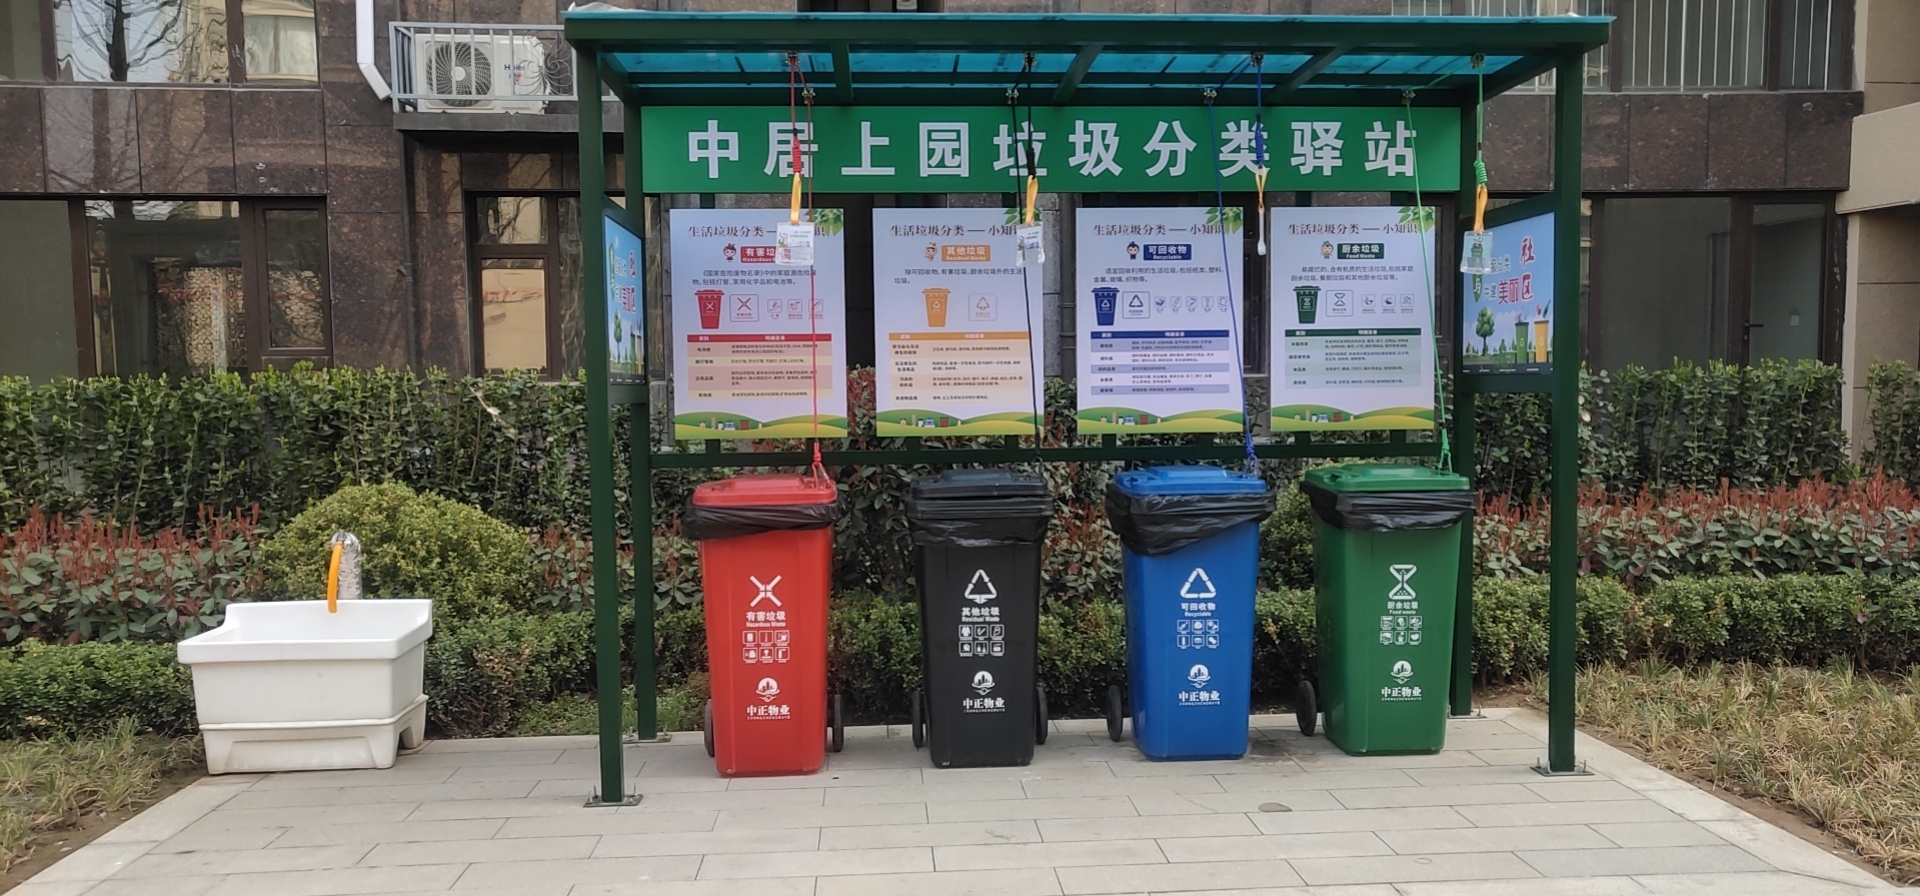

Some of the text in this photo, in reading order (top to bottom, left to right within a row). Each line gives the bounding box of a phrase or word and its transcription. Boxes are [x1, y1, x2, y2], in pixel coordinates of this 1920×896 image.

[688, 119, 1417, 178] 中居上园垃圾分类驿站
[745, 248, 775, 257] 有害垃
[947, 247, 986, 255] 其他垃圾
[1148, 245, 1187, 255] 可回收物
[1342, 245, 1380, 253] 厨余垃圾
[1181, 602, 1216, 611] 可回收物
[1387, 601, 1419, 609] 厨余垃圾
[746, 611, 786, 621] 有害垃圾
[961, 607, 1000, 616] 其他垃圾
[1179, 691, 1220, 702] 中正物业
[1381, 687, 1422, 697] 中正物业
[963, 698, 1005, 709] 中正物业
[747, 705, 790, 716] 中正物业
